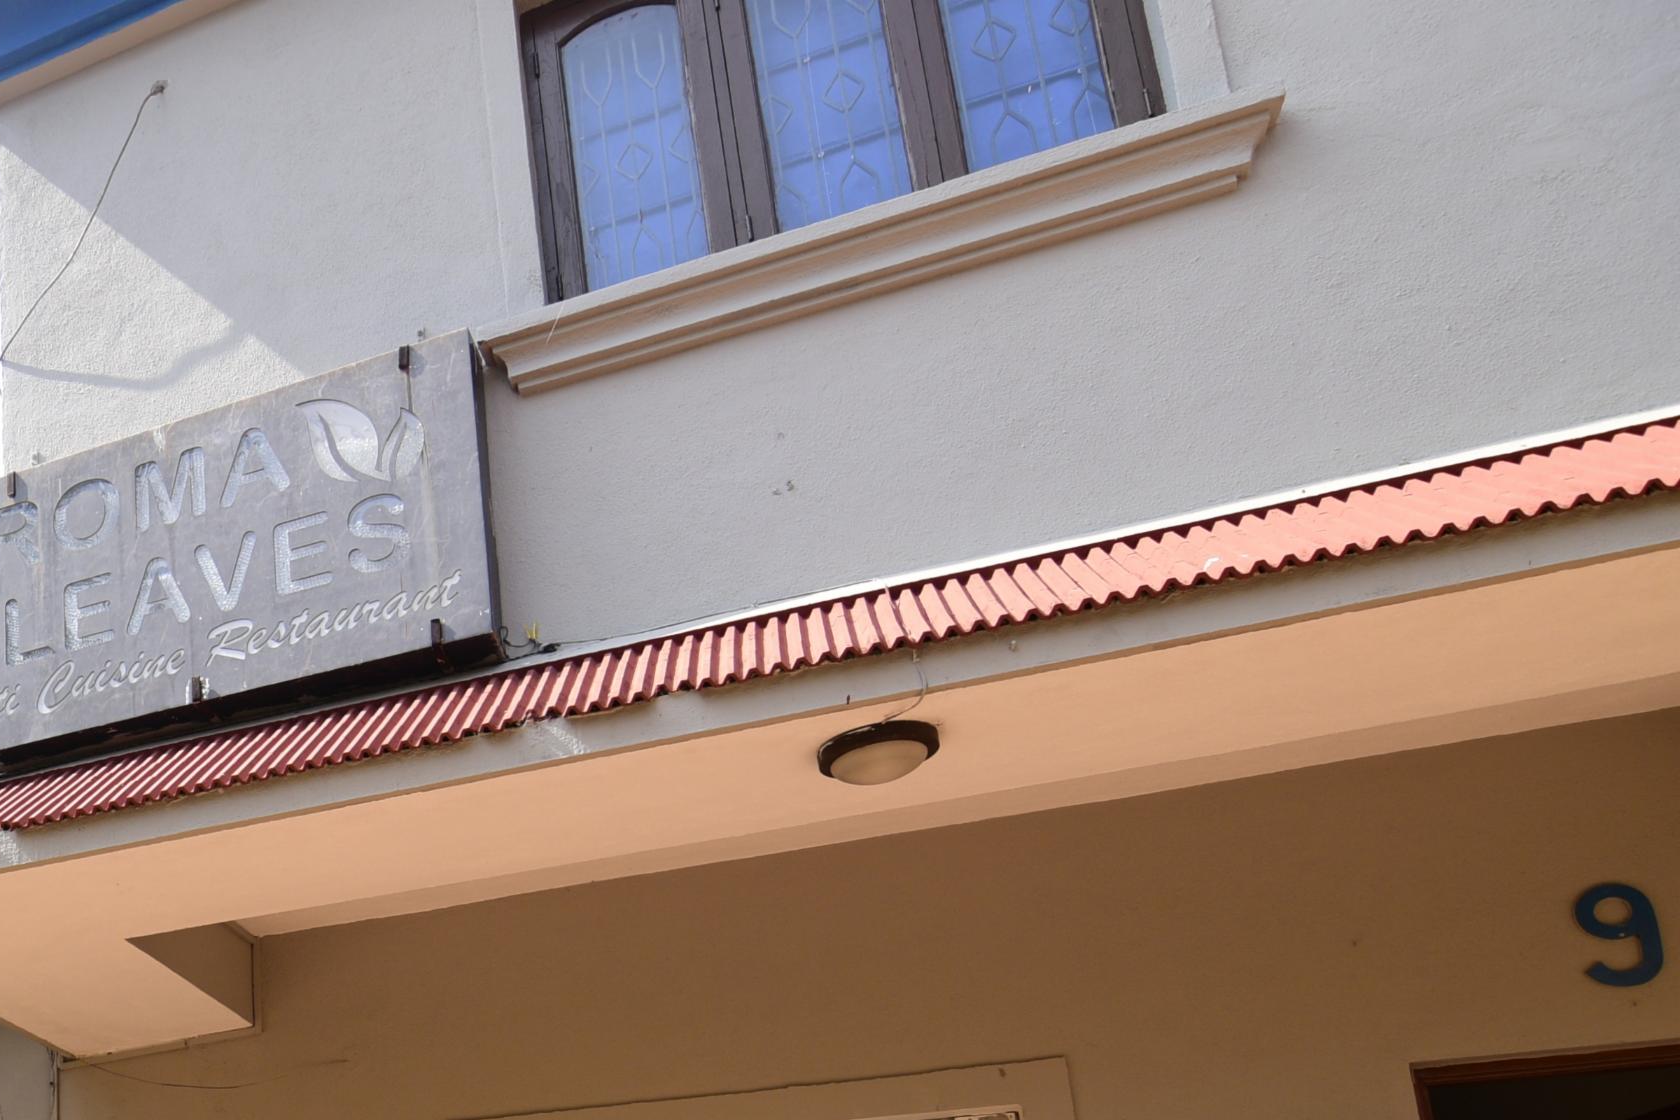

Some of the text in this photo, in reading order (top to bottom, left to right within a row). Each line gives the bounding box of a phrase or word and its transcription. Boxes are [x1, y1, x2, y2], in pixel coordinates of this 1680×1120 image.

[6, 493, 411, 666] LEAVES
[36, 646, 186, 716] Cuisine
[206, 570, 463, 668] Restaurant
[1574, 881, 1664, 988] 9
